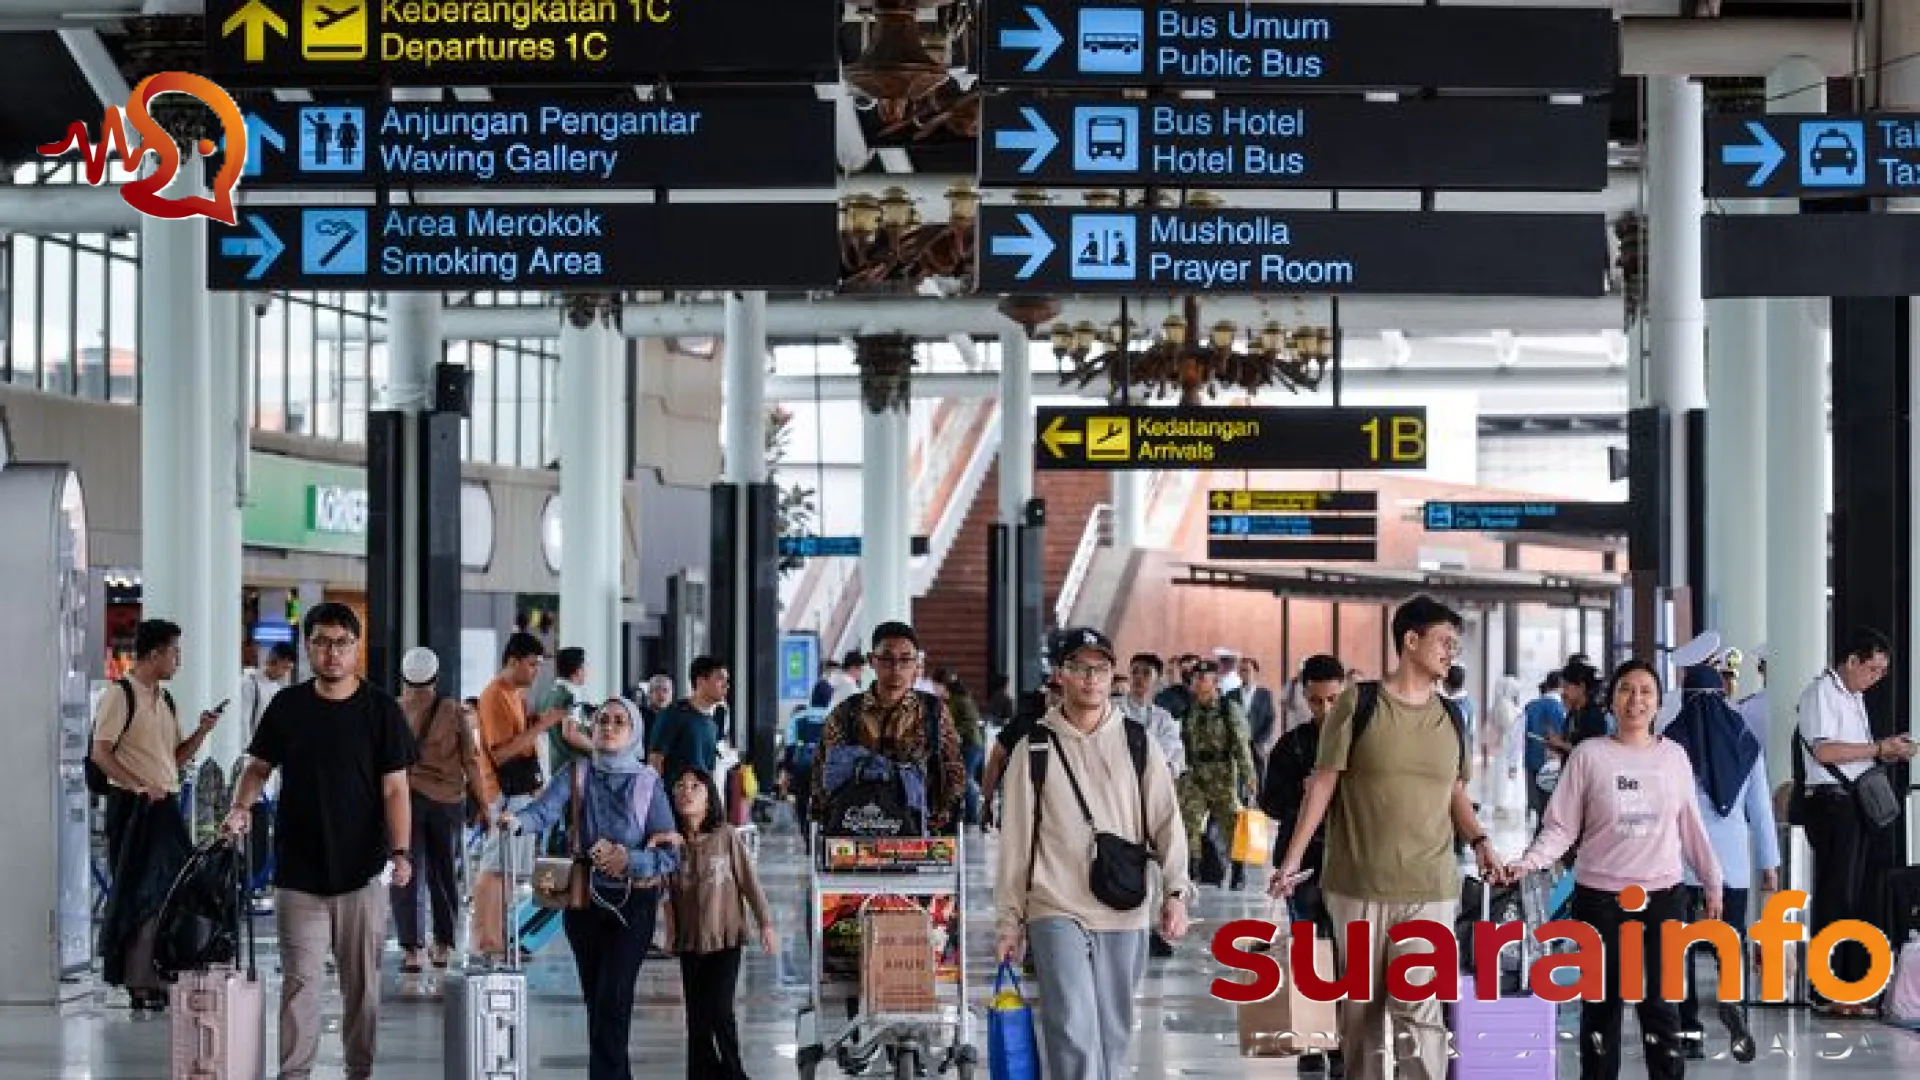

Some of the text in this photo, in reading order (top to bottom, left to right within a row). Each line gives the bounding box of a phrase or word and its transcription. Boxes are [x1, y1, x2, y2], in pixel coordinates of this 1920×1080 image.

[381, 0, 670, 30] Keberangkatan 1C
[1158, 11, 1329, 40] Bus Umum
[381, 32, 607, 66] Departures 1C
[1158, 47, 1322, 78] Public Bus
[381, 107, 700, 141] Anjungan Pengantar
[1154, 107, 1304, 136] Bus Hotel
[381, 143, 618, 179] Waving Gallery
[1154, 145, 1304, 174] Hotel Bus
[383, 209, 602, 237] Area Merokok
[1151, 216, 1290, 245] Musholla
[381, 247, 602, 281] Smoking Area
[1150, 254, 1353, 290] Prayer Room
[1137, 418, 1259, 441] Kedatangan
[1360, 416, 1425, 461] 1B
[1137, 442, 1215, 461] Arrivals
